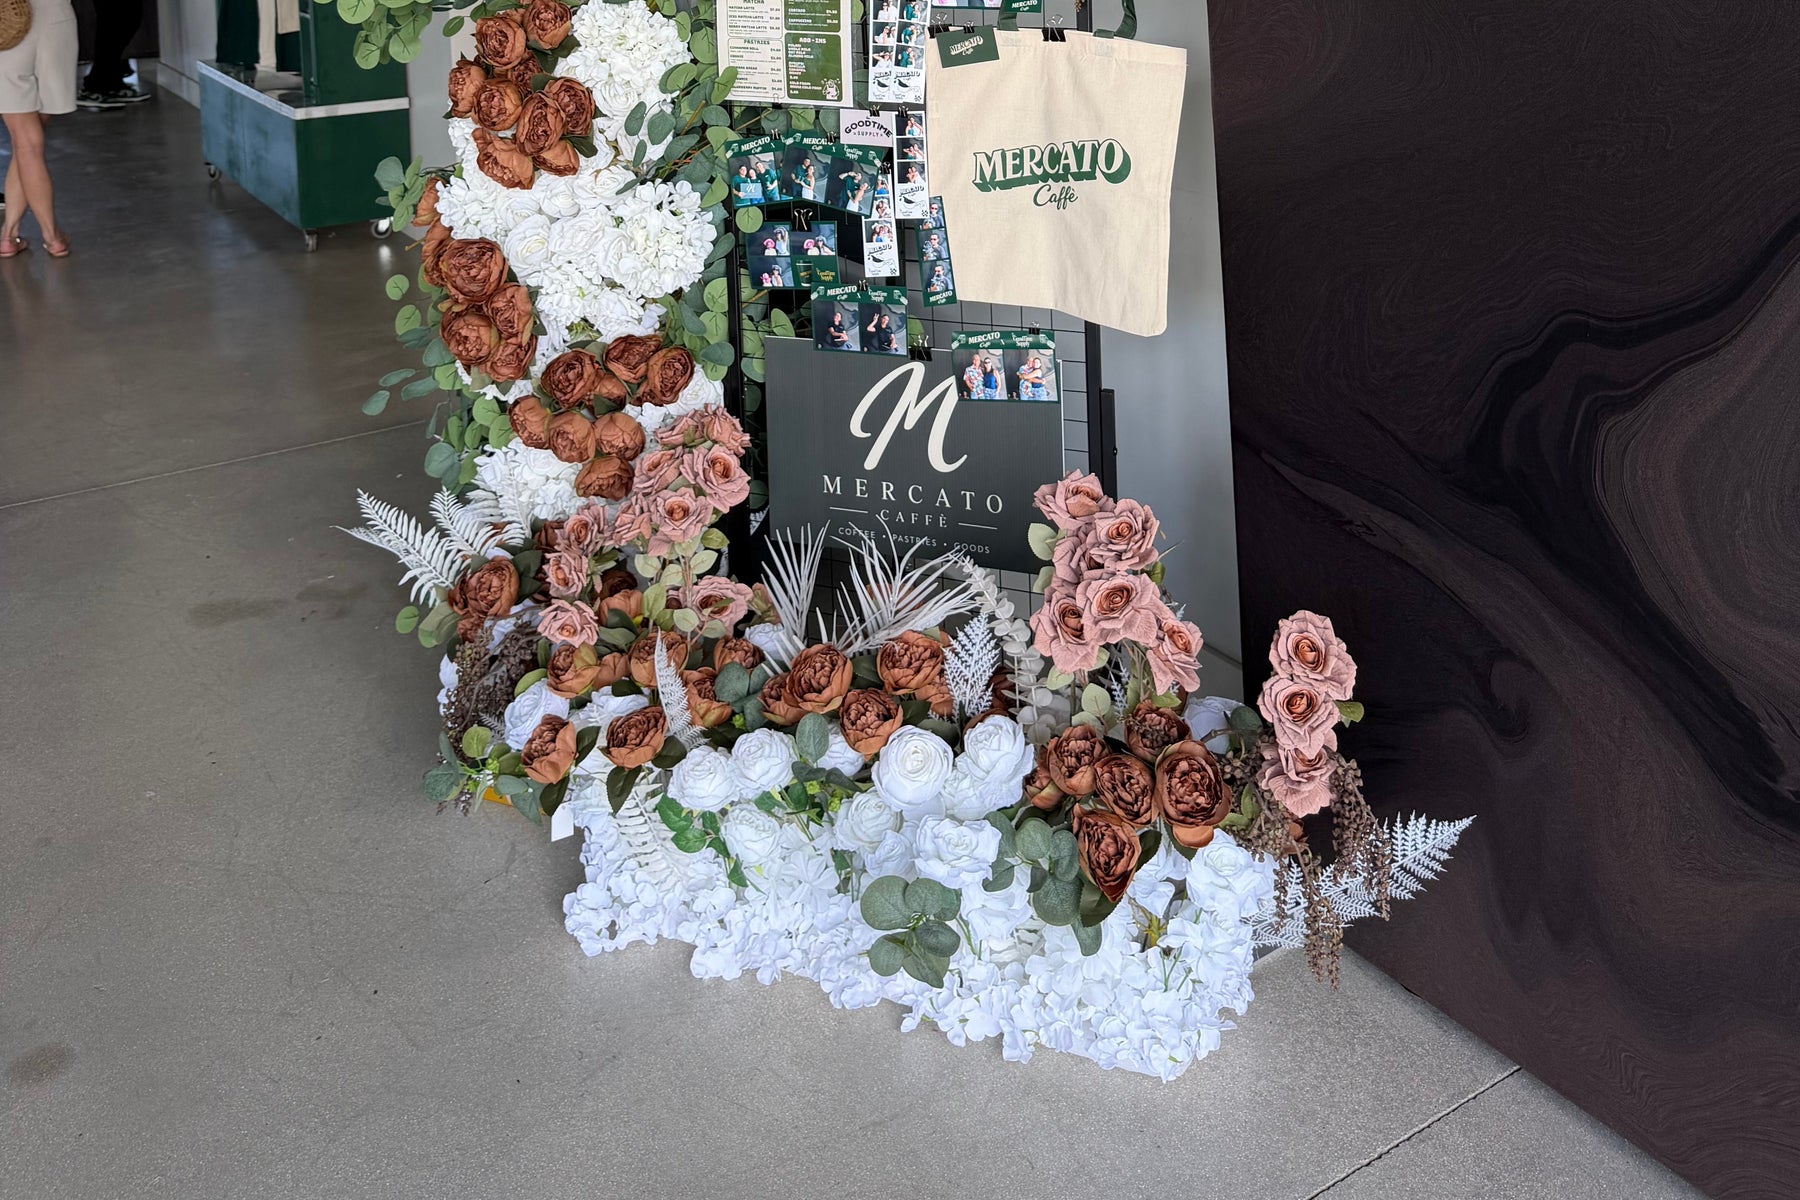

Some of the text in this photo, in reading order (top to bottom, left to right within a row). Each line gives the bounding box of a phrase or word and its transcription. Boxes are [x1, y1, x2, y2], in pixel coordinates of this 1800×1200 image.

[1011, 0, 1038, 9] MERCATO
[949, 35, 984, 56] MERCATO
[844, 119, 893, 138] GOODTIME
[740, 135, 771, 153] MERCATO
[973, 138, 1131, 192] MERCATO
[1033, 184, 1078, 210] Caffè
[826, 285, 857, 297] MERCATO
[929, 290, 953, 303] MERCATO
[968, 331, 1000, 345] MERCATO
[849, 361, 968, 473] M
[822, 474, 1003, 514] MERCATO
[880, 509, 948, 528] CAFFÈ
[838, 527, 876, 539] COFFEE
[953, 542, 990, 554] GOODS
